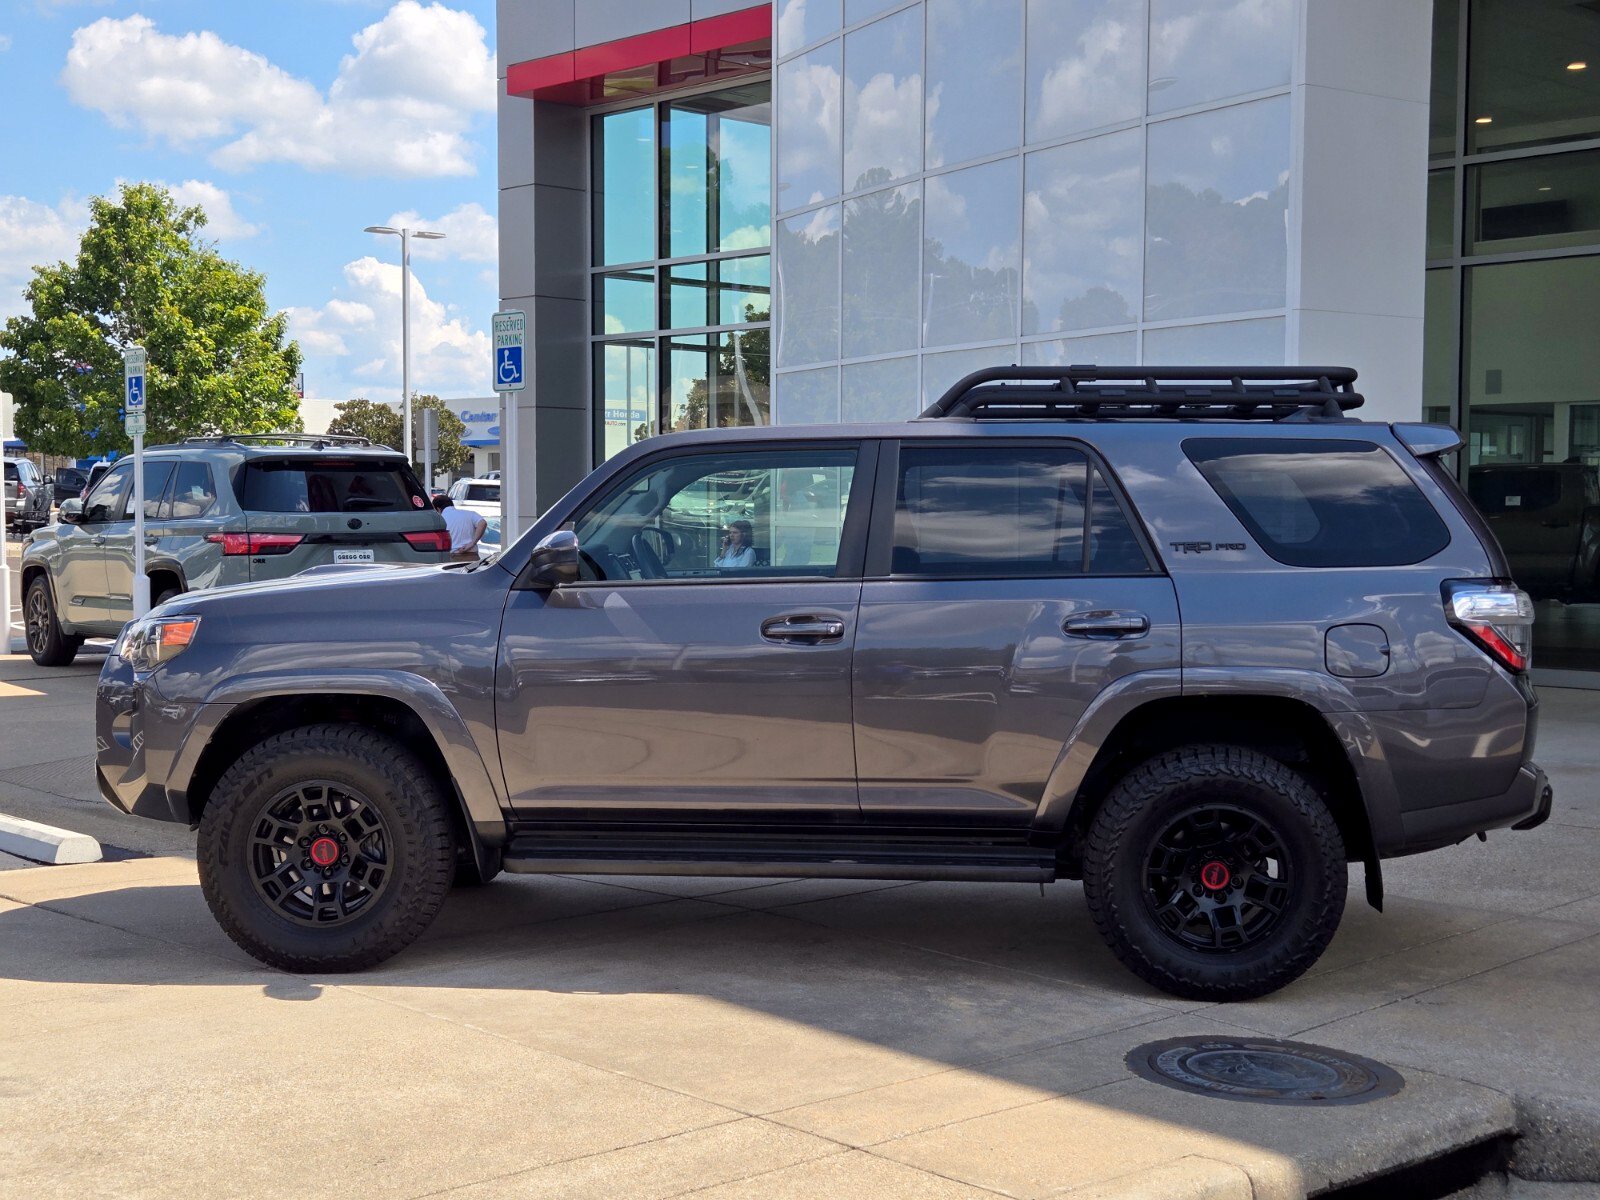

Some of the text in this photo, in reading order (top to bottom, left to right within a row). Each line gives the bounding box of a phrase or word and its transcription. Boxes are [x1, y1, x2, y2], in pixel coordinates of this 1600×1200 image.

[495, 319, 523, 332] RESERVED
[497, 333, 522, 346] PARKING
[461, 411, 497, 422] Center
[1170, 542, 1247, 554] TRD PRO
